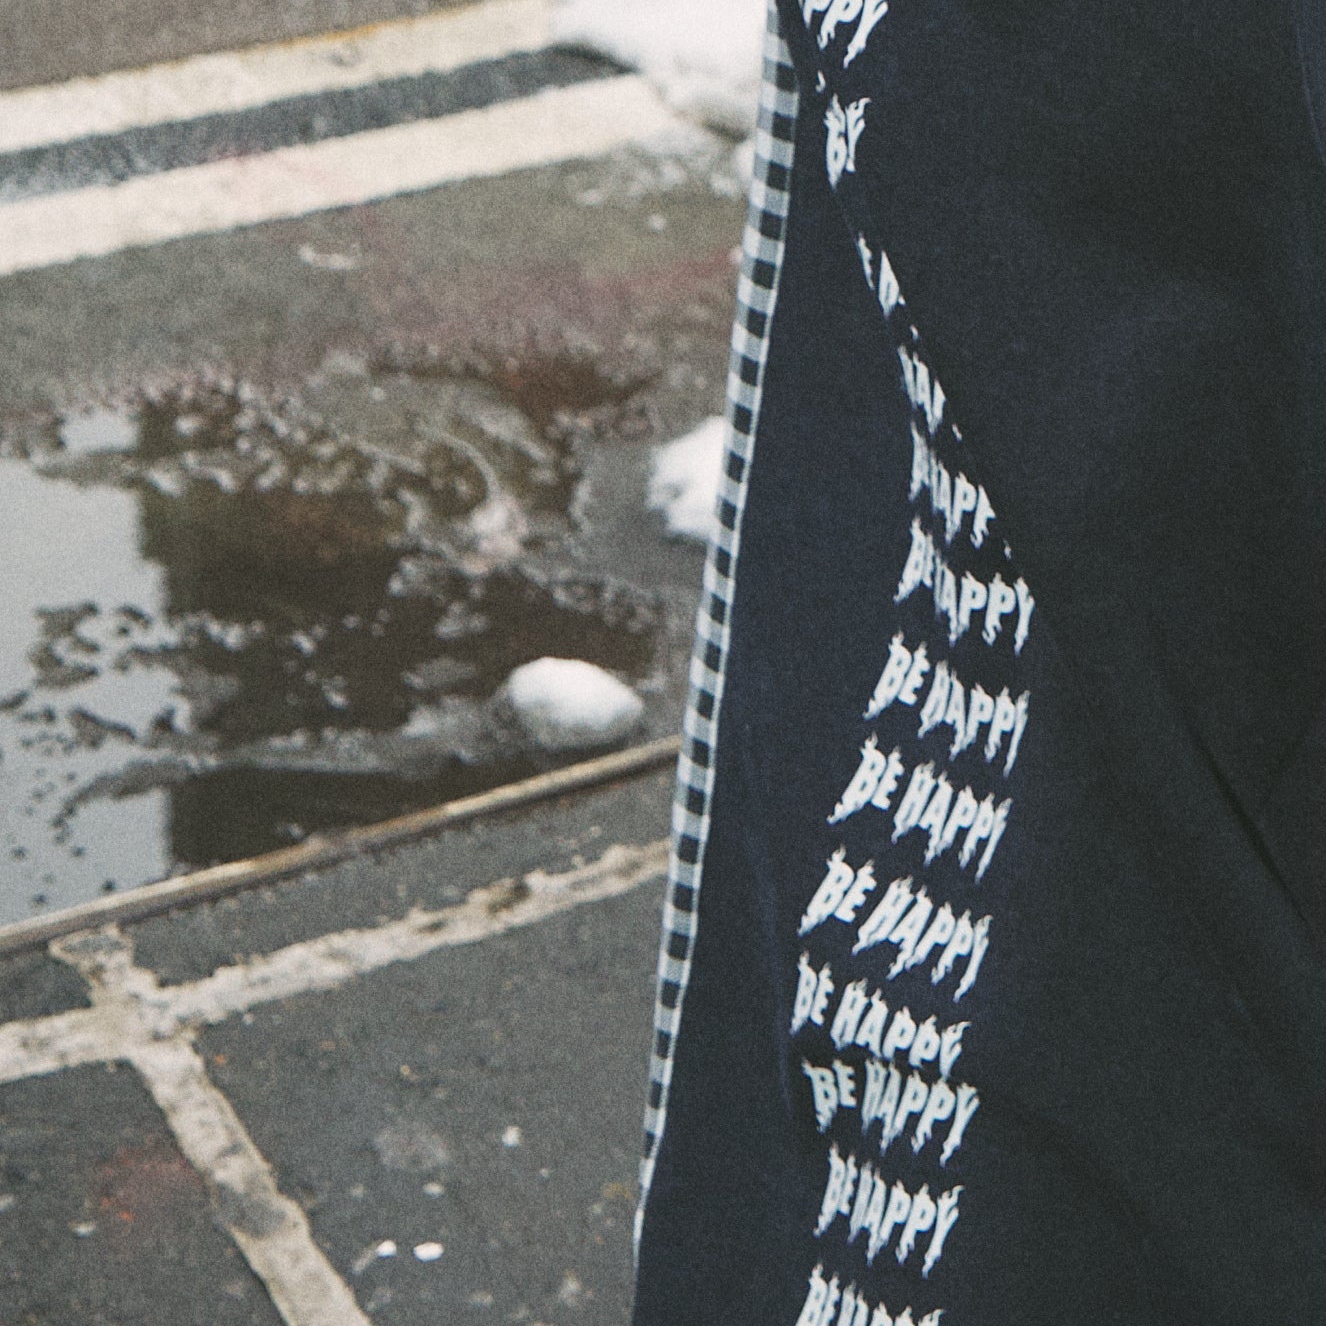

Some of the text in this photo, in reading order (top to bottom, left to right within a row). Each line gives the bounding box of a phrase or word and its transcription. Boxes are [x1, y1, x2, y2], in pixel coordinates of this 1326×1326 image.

[863, 631, 1031, 780] BE HAPPY
[827, 731, 1013, 883] BE HAPPY
[797, 843, 994, 1004] BE HAPPY
[789, 950, 972, 1080] BE HAPPY
[802, 1057, 981, 1167] BE HAPPY
[813, 1141, 965, 1279] BE HAPPY
